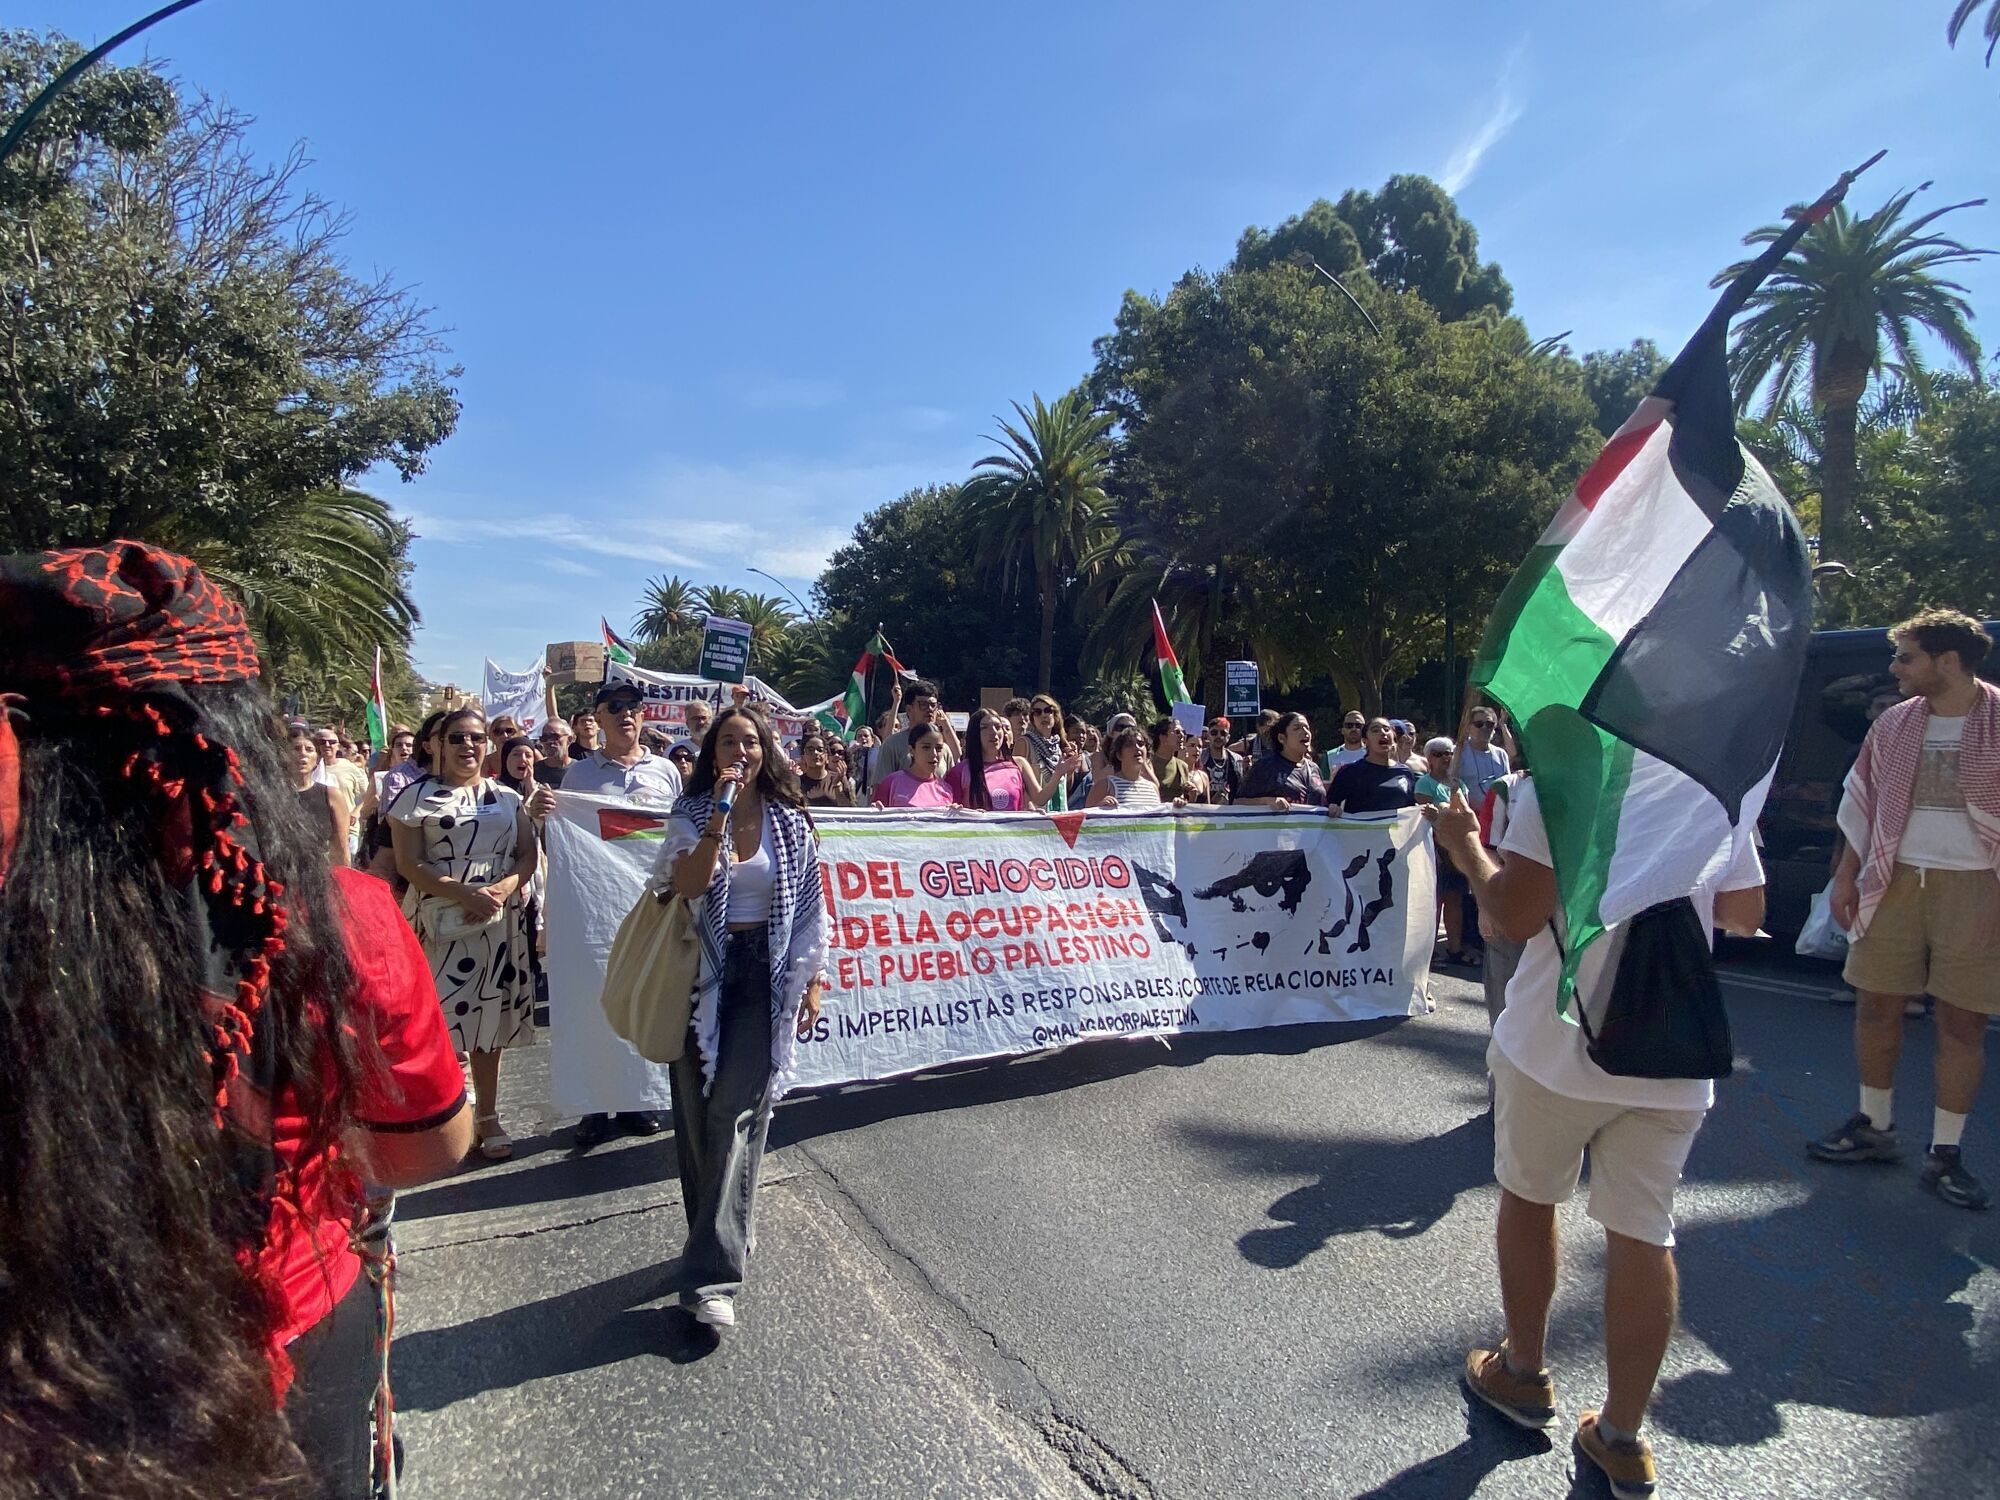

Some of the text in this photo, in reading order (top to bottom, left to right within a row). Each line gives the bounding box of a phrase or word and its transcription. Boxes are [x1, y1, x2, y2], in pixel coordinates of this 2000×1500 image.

[837, 861, 914, 900] DEL
[919, 855, 1131, 899] GENOCIDIO
[842, 914, 893, 950] DE
[896, 910, 940, 946] LA
[945, 893, 1145, 942] OCUPACIÓN
[838, 932, 1151, 990] EL PUEBLO PALESTINO
[838, 993, 1015, 1039] IMPERIALISTAS
[1245, 969, 1357, 992] RELACIONES
[1361, 967, 1394, 987] YA!
[1032, 1004, 1200, 1046] @MALAGAPORPALESTINA
